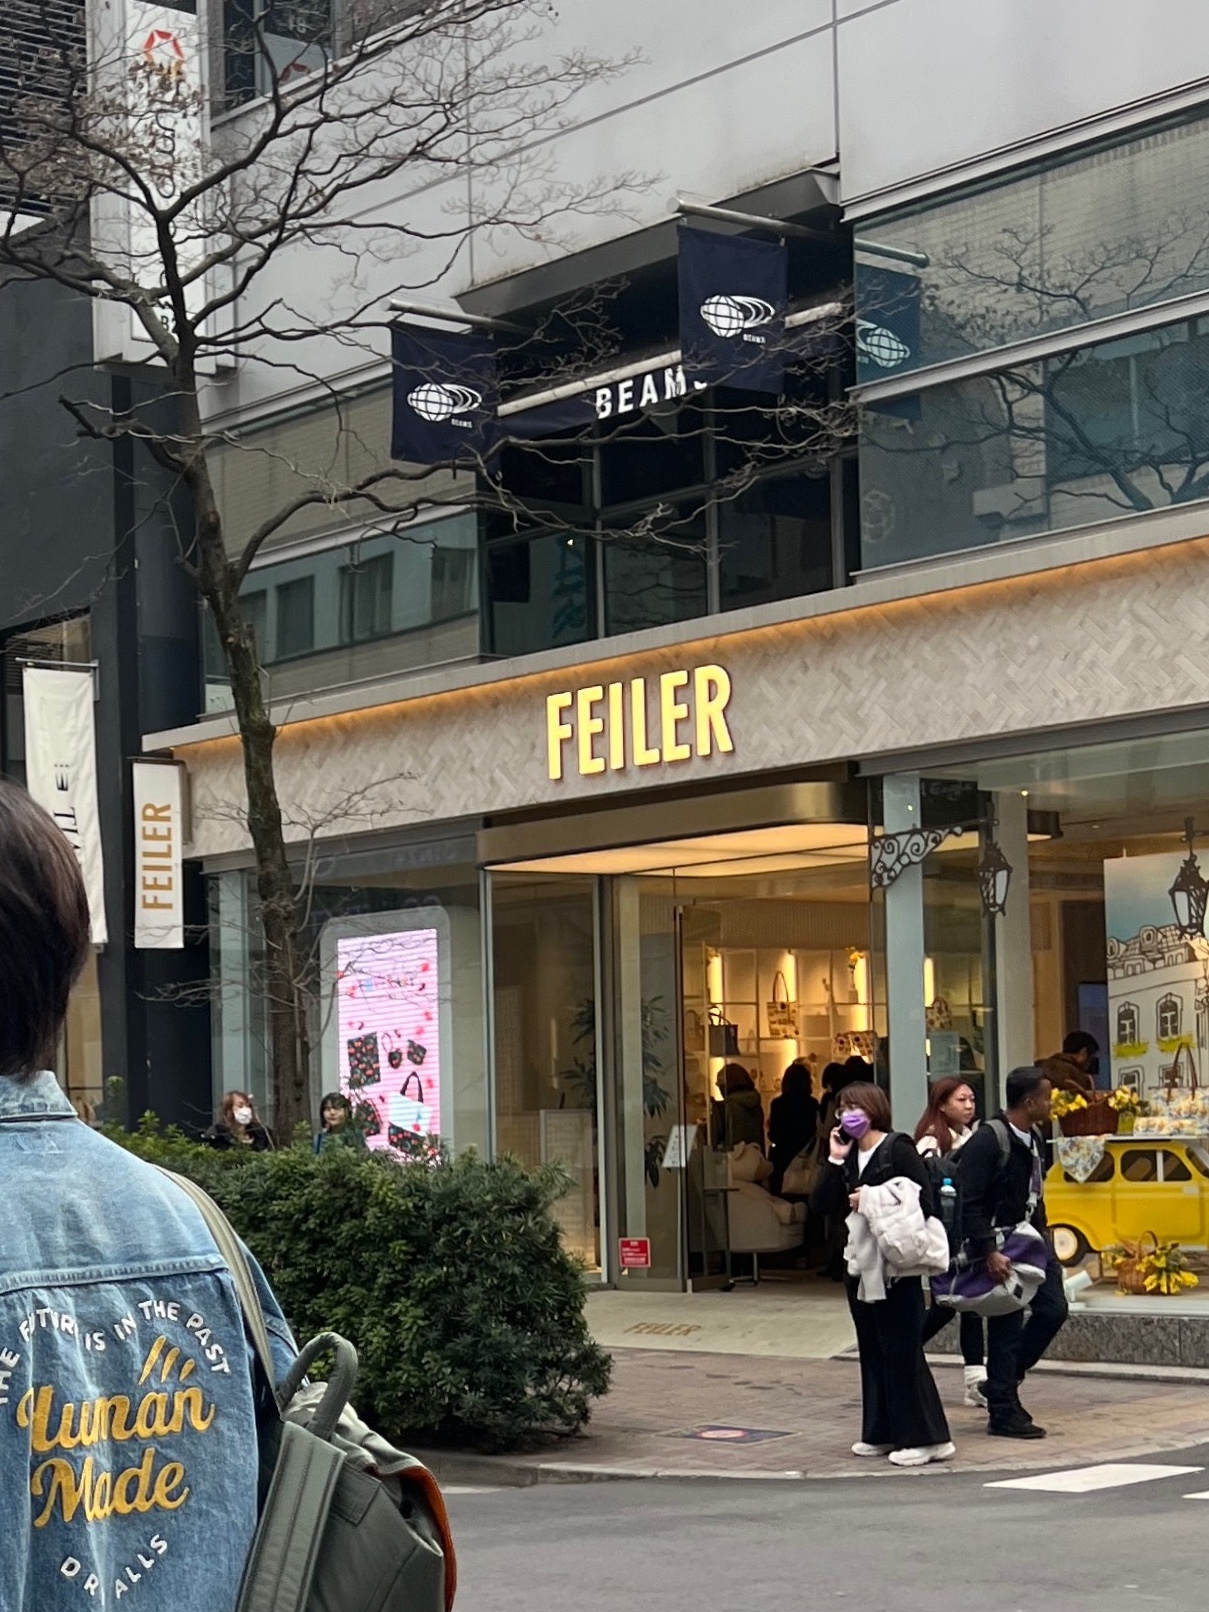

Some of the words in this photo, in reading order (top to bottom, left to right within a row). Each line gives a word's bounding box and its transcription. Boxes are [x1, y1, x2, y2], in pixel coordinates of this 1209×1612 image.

[595, 365, 708, 419] BEAM
[546, 664, 734, 780] FEILER
[142, 802, 173, 910] FEILER
[84, 1332, 106, 1352] IS
[113, 1311, 137, 1341] IN
[137, 1300, 181, 1322] THE
[186, 1312, 231, 1374] PAST
[31, 1447, 190, 1528] Made
[60, 1556, 105, 1606] DR
[115, 1533, 168, 1599] ALLS
